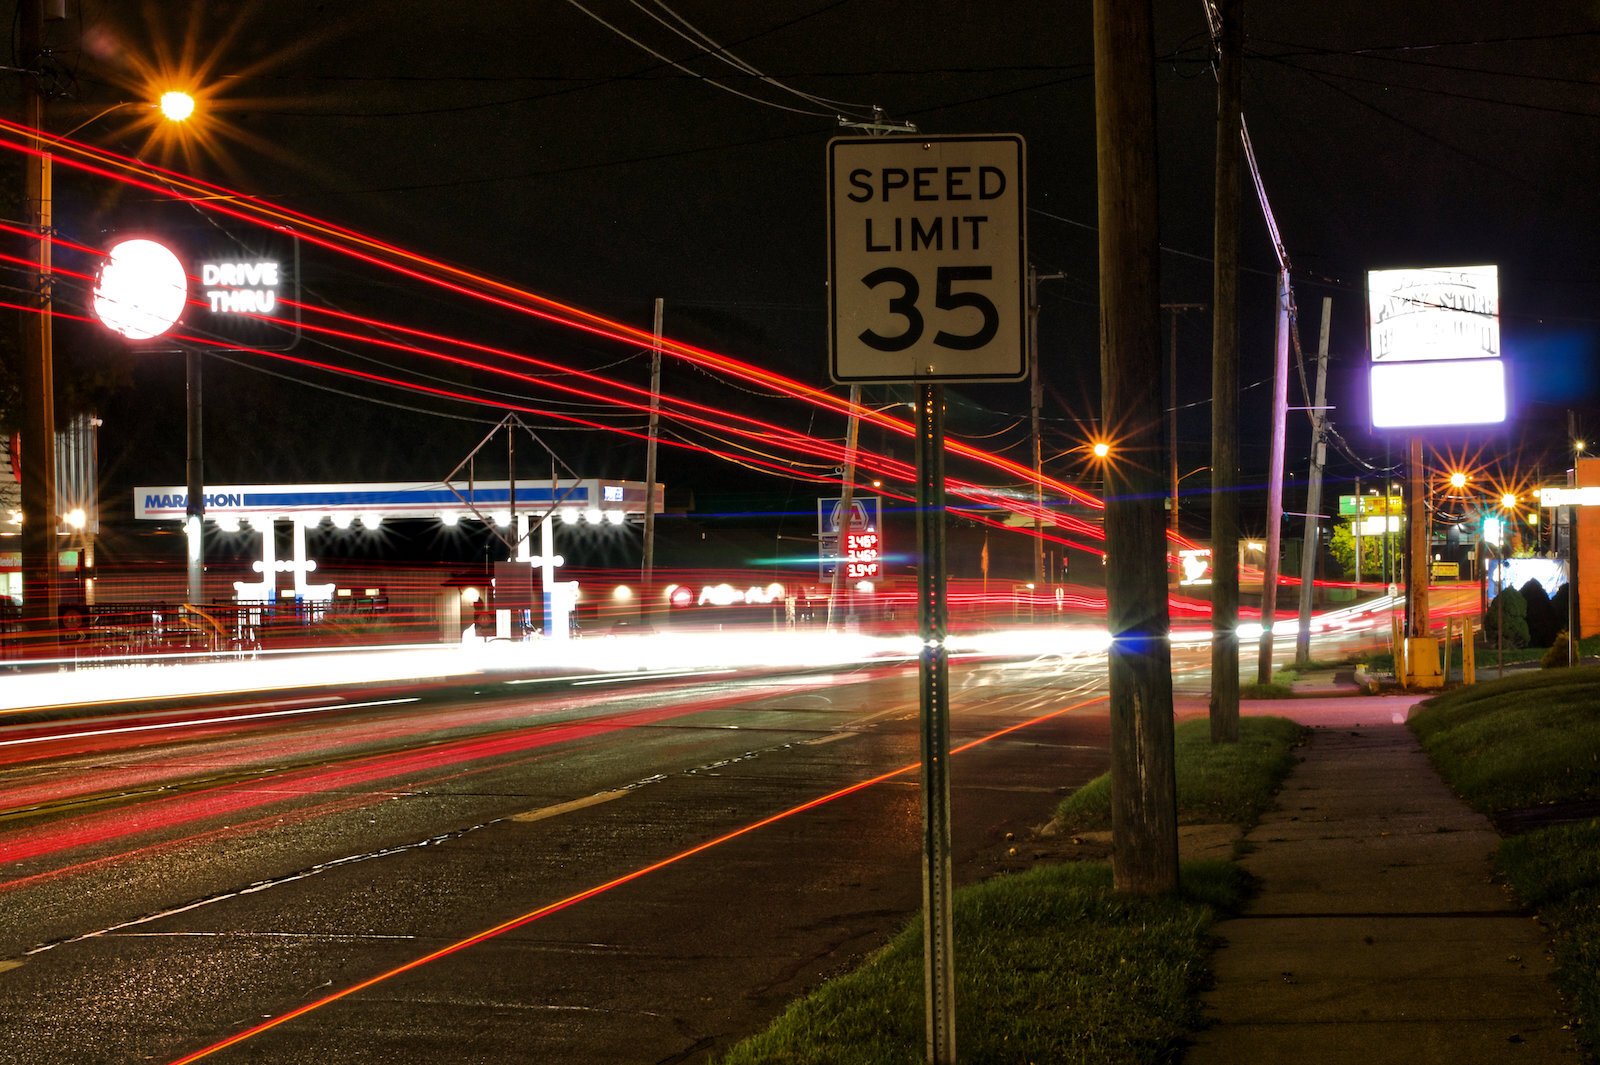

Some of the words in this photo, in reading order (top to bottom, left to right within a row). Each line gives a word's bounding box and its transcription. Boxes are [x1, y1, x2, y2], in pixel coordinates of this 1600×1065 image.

[847, 166, 1006, 203] SPEED
[865, 216, 988, 252] LIMIT
[203, 263, 279, 285] DRIVE
[207, 290, 275, 312] THRU
[858, 266, 999, 352] 35
[144, 493, 241, 508] MARAHON
